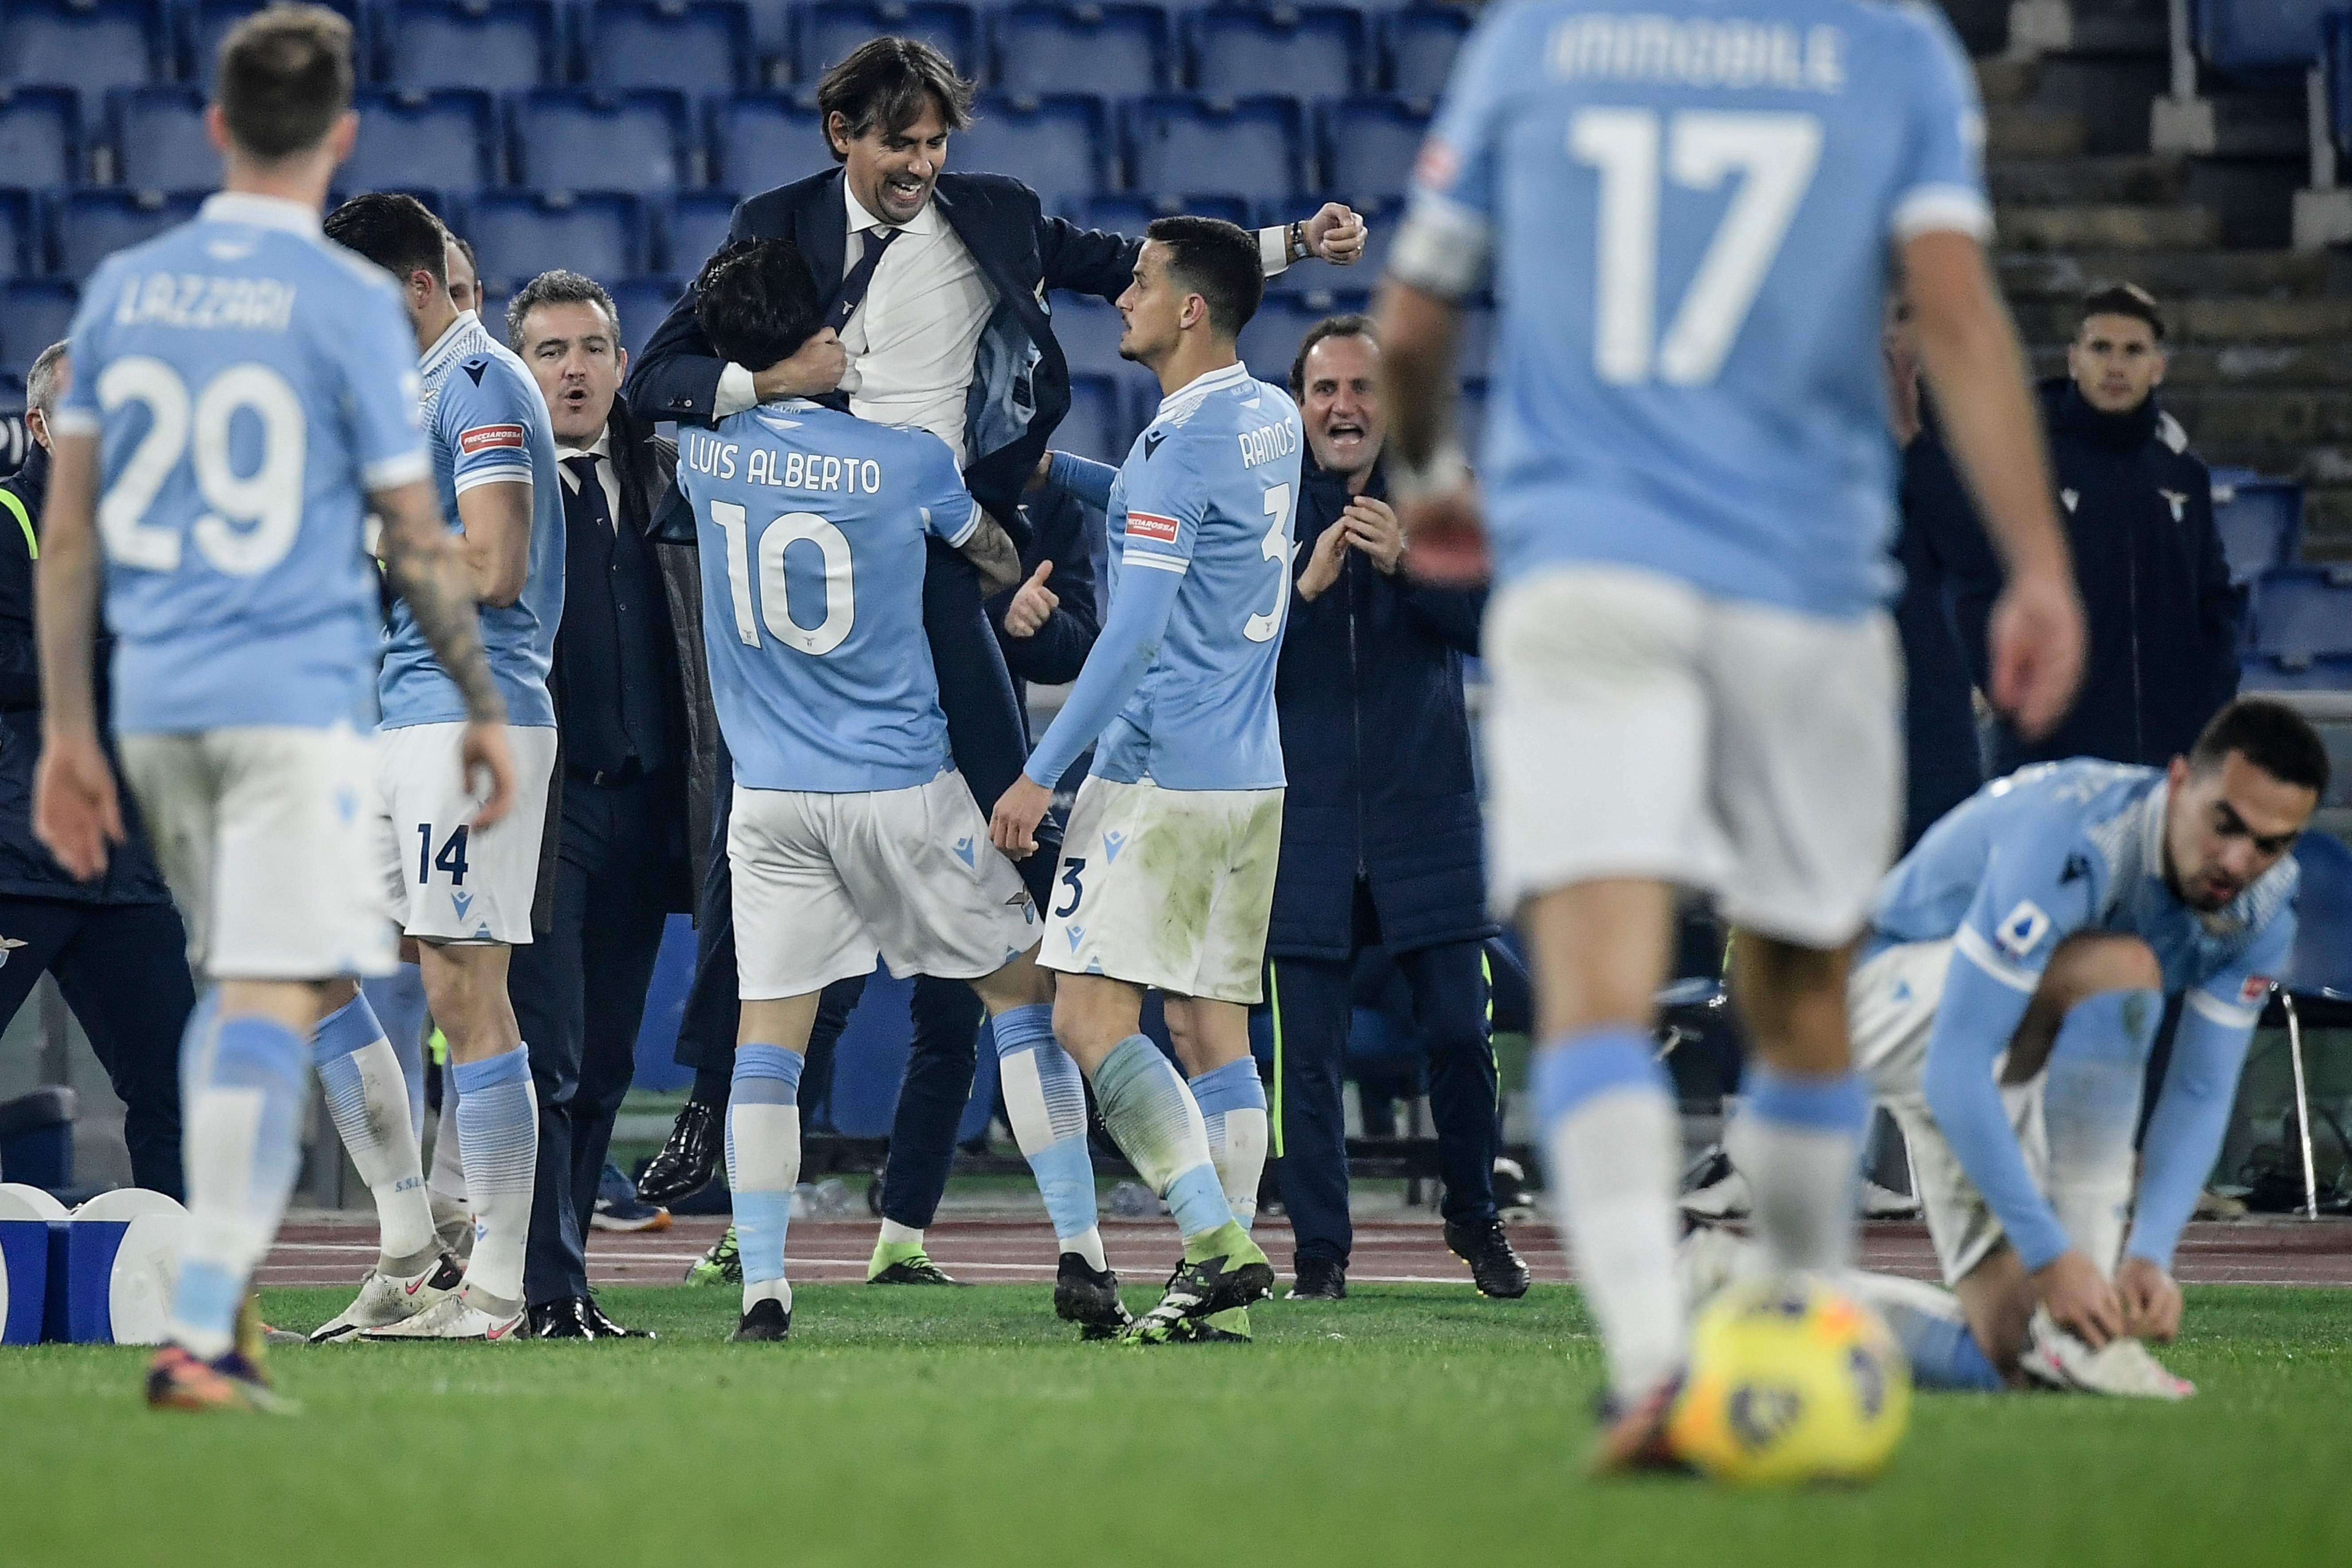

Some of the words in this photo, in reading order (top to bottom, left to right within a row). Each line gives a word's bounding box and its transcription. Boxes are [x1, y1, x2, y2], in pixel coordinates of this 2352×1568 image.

[1568, 105, 1823, 386] 17
[115, 271, 296, 335] LAZZARI
[95, 357, 306, 576] 29
[464, 431, 521, 444] FRECCIAROSSA
[689, 432, 739, 480] LUIS
[746, 448, 880, 494] ALBERTO
[1238, 416, 1296, 470] RAMOS
[711, 499, 854, 656] 10
[1243, 482, 1291, 642] 3
[417, 823, 469, 886] 14
[1055, 857, 1086, 918] 3
